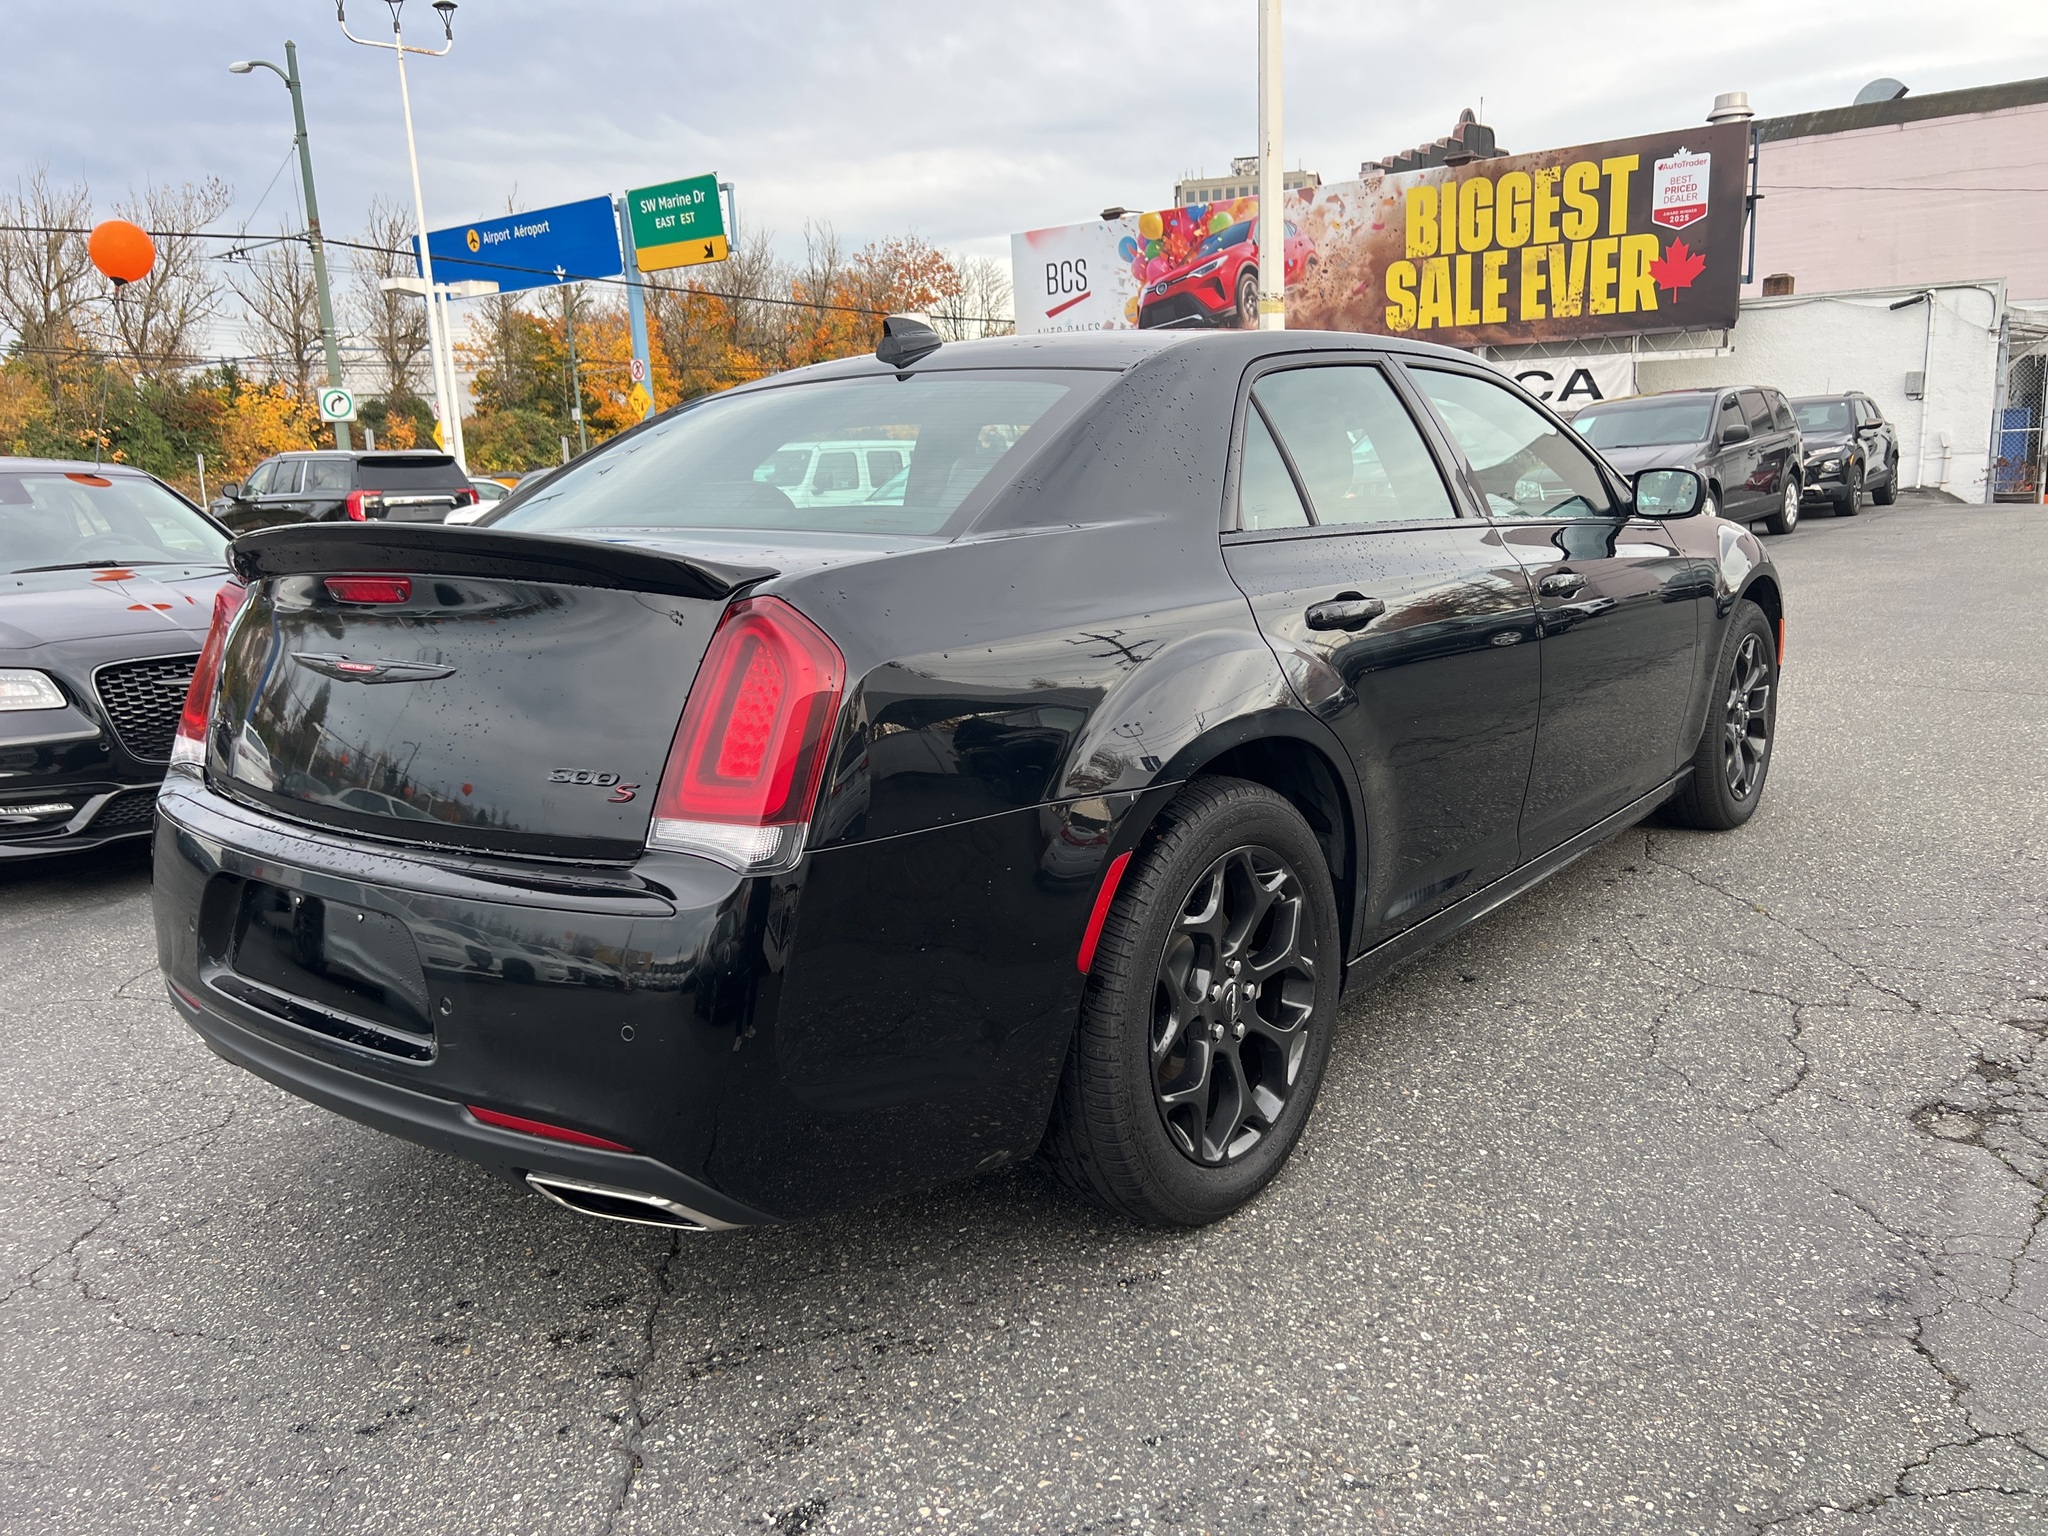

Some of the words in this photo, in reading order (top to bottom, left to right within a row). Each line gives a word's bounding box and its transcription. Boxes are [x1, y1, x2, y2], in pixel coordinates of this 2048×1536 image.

[1662, 159, 1707, 171] AutoTrader
[1670, 175, 1693, 185] BEST
[1664, 183, 1697, 195] PRICED
[640, 198, 656, 213] SW
[658, 193, 692, 210] Marine
[693, 189, 705, 204] Dr
[1405, 154, 1639, 259] BIGGEST
[1663, 193, 1698, 204] DEALER
[655, 215, 676, 229] EAST
[680, 212, 695, 225] EST
[1669, 214, 1690, 223] 2025
[483, 228, 511, 245] Airport
[514, 220, 550, 238] Aéroport
[1046, 258, 1087, 295] BCS
[1385, 249, 1508, 332] SALE
[1520, 233, 1660, 321] EVER
